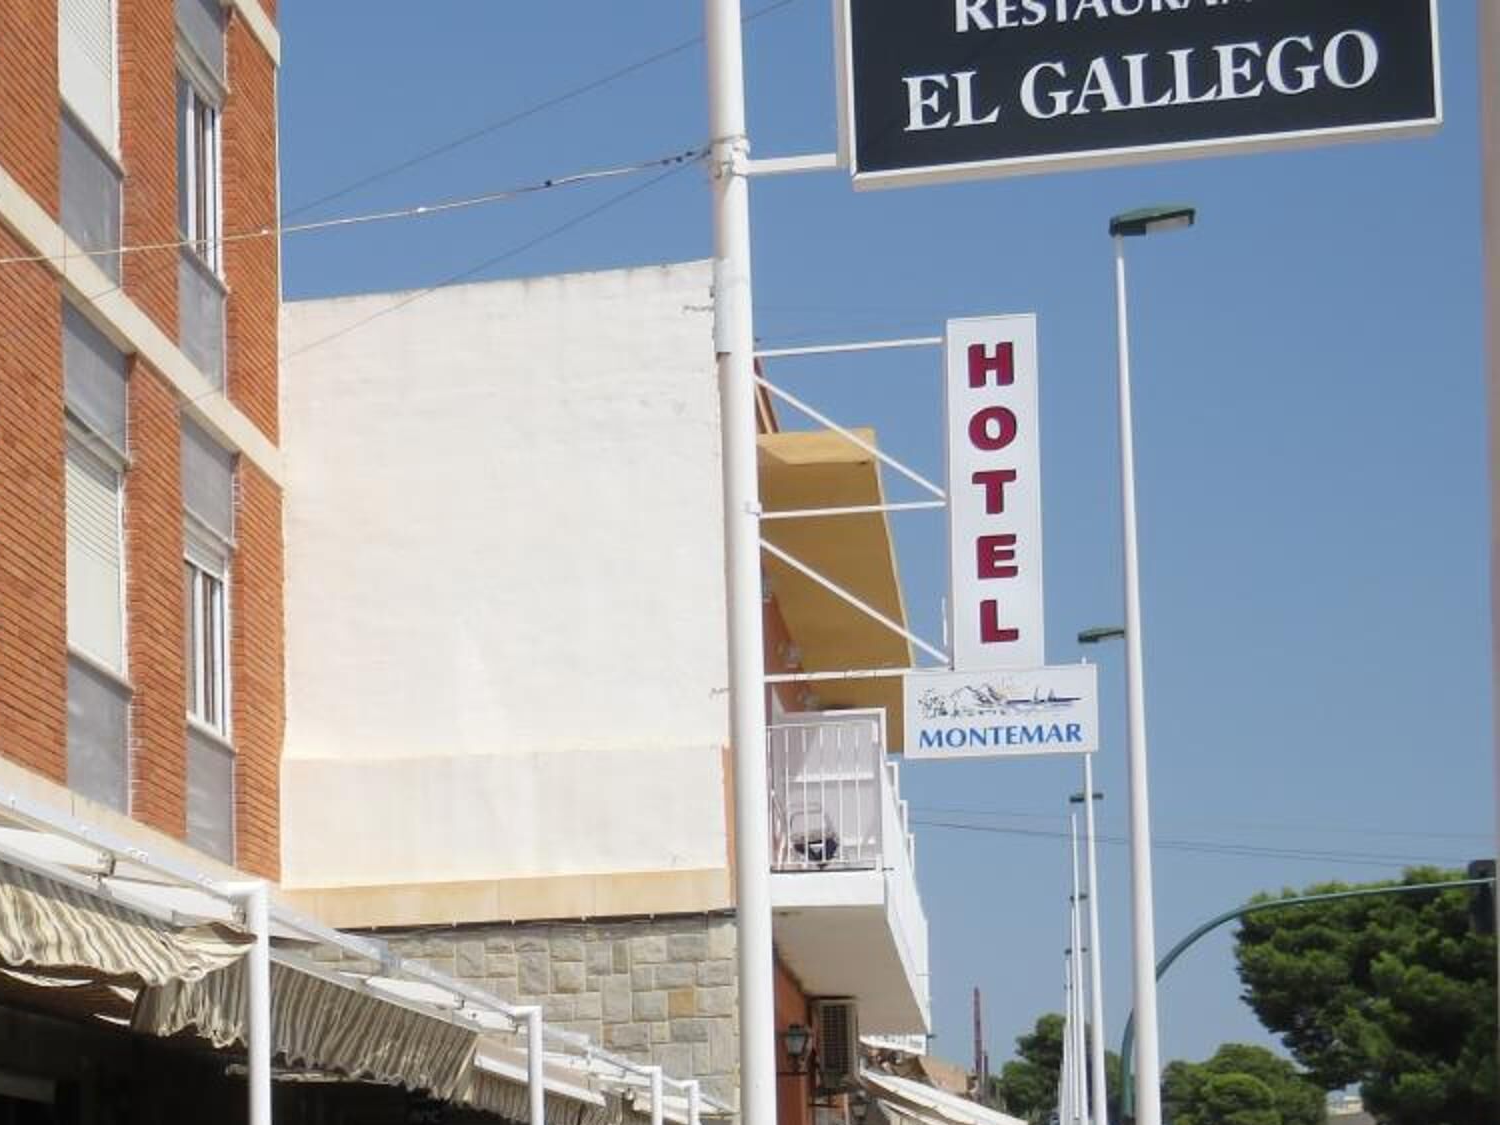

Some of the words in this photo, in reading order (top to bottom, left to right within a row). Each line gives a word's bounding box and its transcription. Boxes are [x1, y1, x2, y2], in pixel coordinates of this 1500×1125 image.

[902, 71, 1001, 132] EL
[1019, 29, 1380, 119] GALLEGO
[967, 341, 1019, 644] HOTEL
[918, 722, 1083, 750] MONTEMAR
